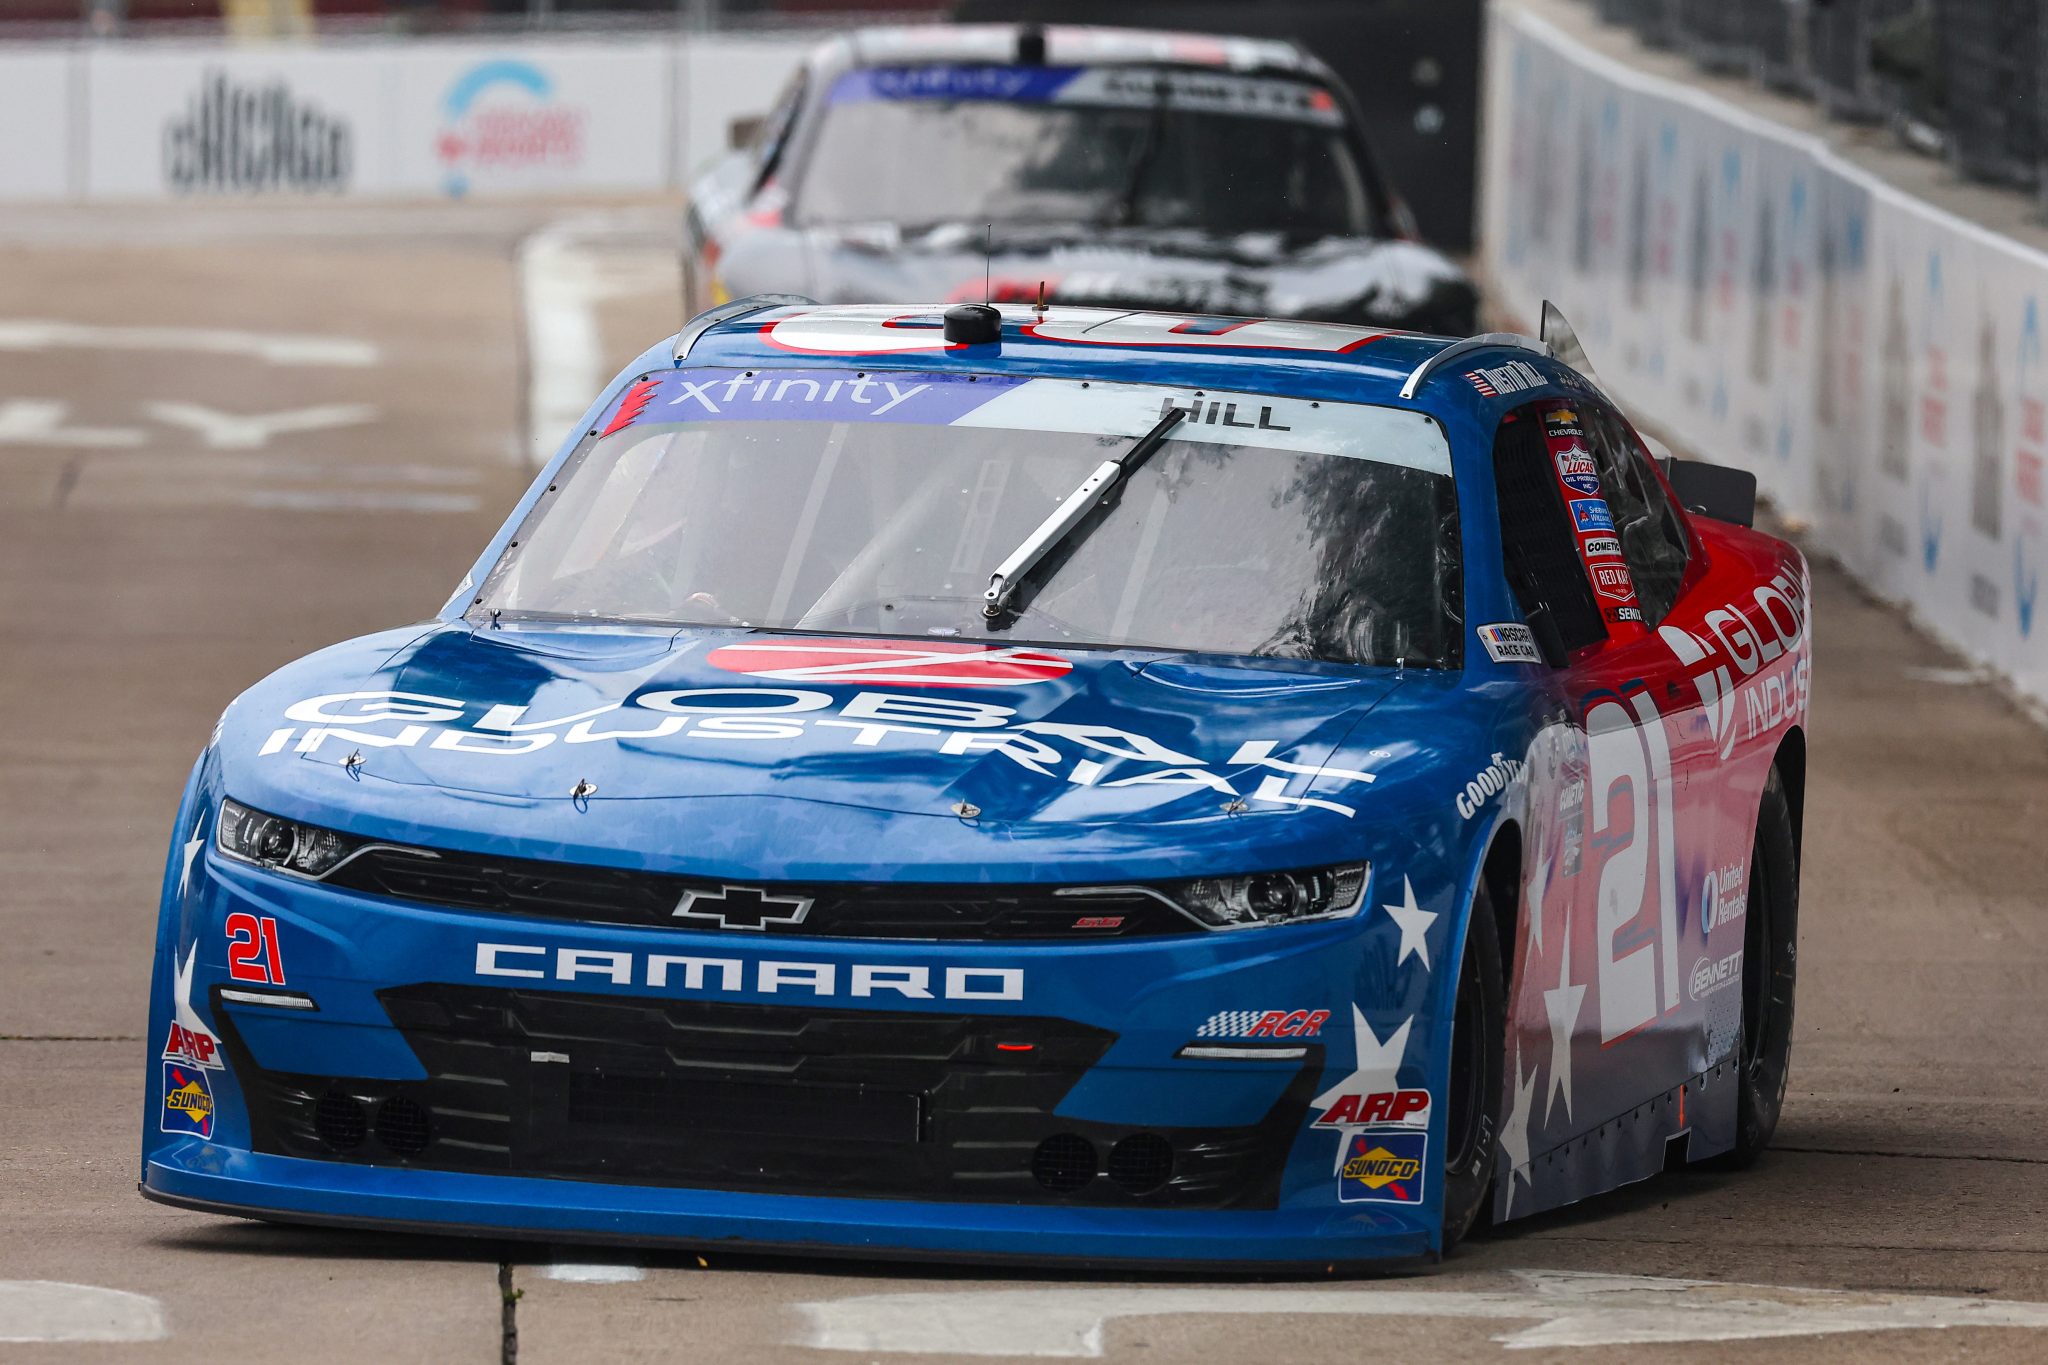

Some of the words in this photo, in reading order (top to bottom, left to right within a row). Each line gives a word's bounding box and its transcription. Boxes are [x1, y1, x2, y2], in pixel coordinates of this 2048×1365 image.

[668, 371, 932, 416] xfinity
[1159, 397, 1291, 431] HILL
[1549, 428, 1584, 437] CHEVROLE
[1566, 461, 1594, 474] LUCAS
[1598, 569, 1617, 586] RED
[1704, 556, 1809, 676] GLOBA
[1496, 644, 1521, 656] RACE
[1520, 645, 1537, 657] CAR
[1498, 627, 1530, 643] NASCAR
[284, 688, 1377, 784] GLOBAL
[258, 716, 1357, 818] INDUSTRIAL
[1585, 690, 1681, 1047] 21
[1719, 857, 1744, 894] United
[1718, 888, 1745, 926] Rentals
[225, 912, 286, 985] 21
[475, 942, 1024, 1001] CAMARO
[1693, 950, 1743, 994] BENNETT
[1247, 1009, 1331, 1037] RCR
[166, 1022, 216, 1063] ARP
[169, 1090, 212, 1113] SUNOCO
[1318, 1090, 1430, 1123] ARP
[1345, 1159, 1417, 1178] SUNOCO
